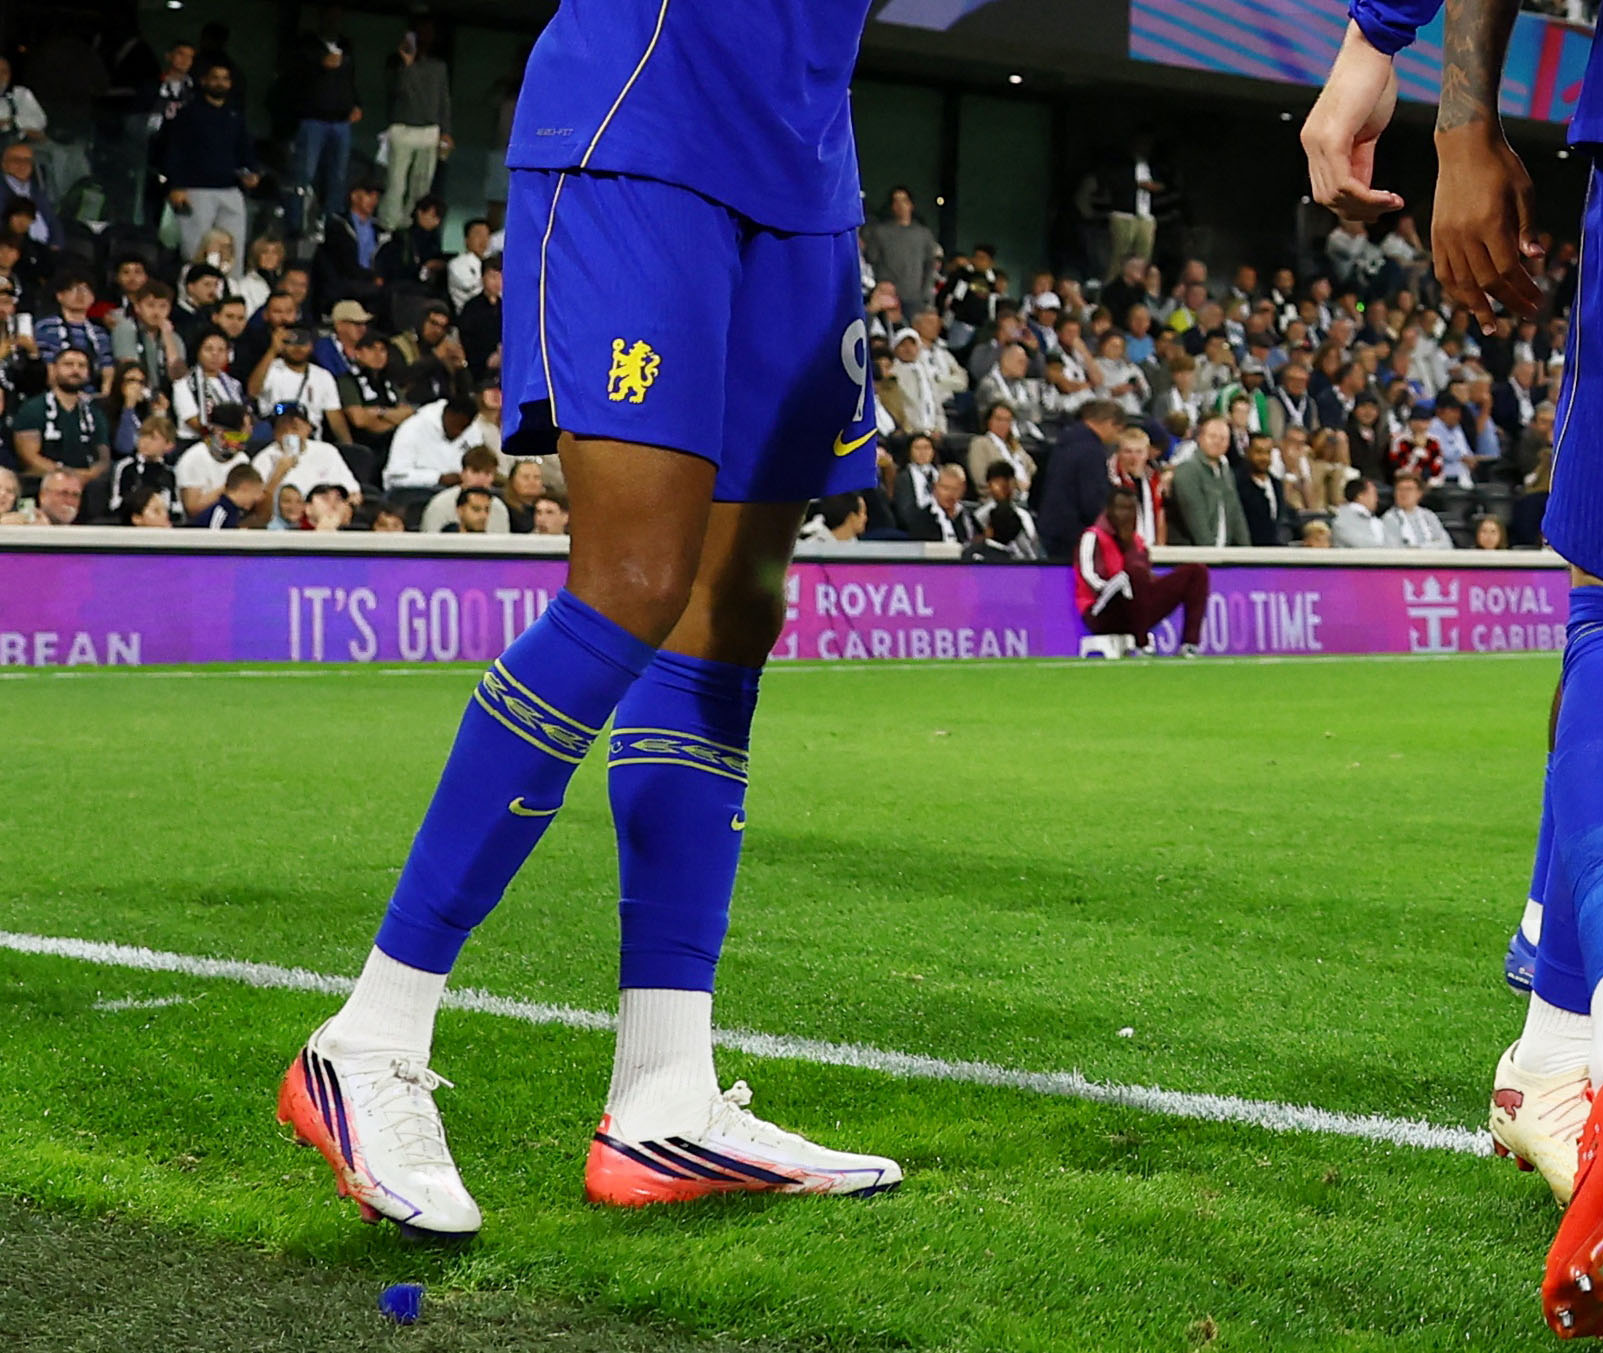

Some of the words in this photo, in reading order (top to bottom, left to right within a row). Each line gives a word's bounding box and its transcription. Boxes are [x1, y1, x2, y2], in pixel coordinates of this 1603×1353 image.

[841, 318, 868, 423] 9
[815, 583, 934, 617] ROYAL
[1249, 591, 1323, 652] TIME
[1468, 585, 1554, 615] ROYAL
[289, 586, 378, 662] IT'S
[817, 628, 1029, 660] CARIBBEAN
